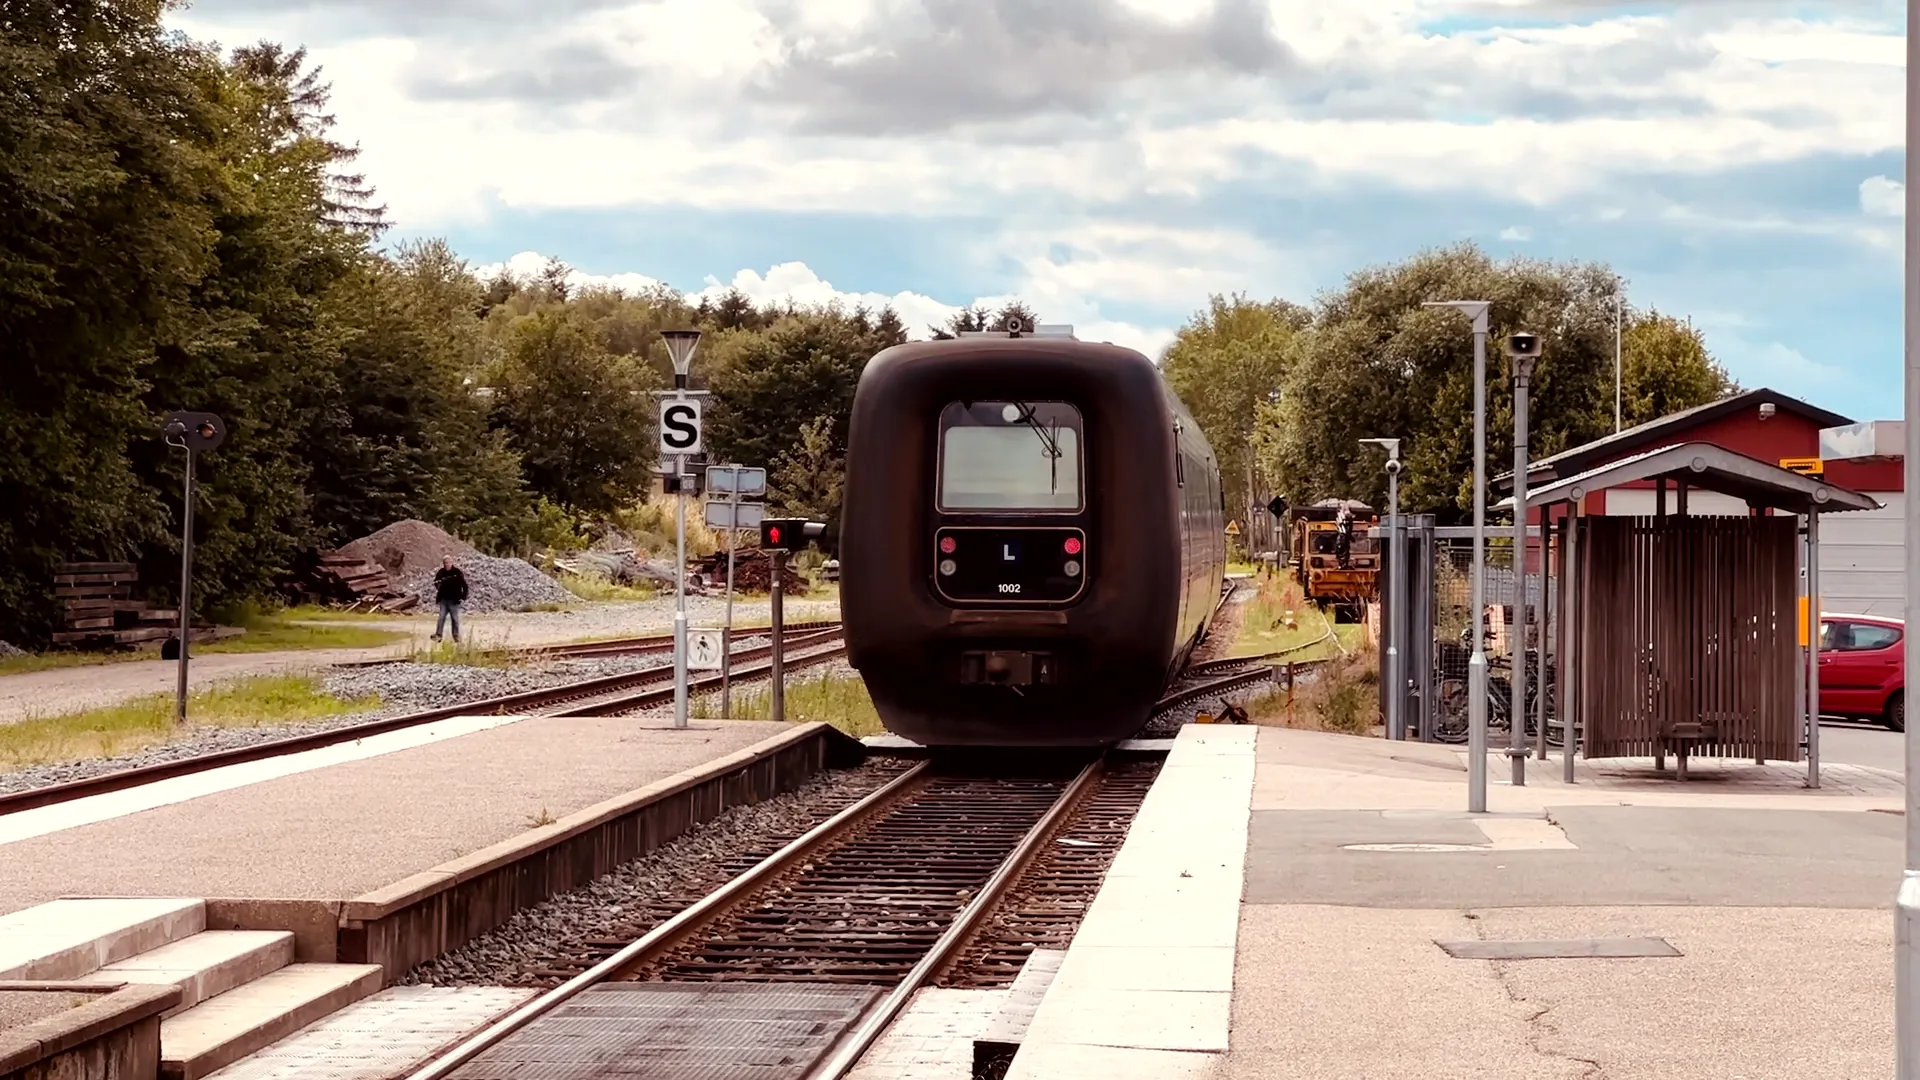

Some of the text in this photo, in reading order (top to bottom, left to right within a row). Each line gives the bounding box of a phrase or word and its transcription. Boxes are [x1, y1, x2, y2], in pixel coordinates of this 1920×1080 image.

[662, 405, 698, 448] S
[1003, 544, 1016, 561] L
[997, 583, 1021, 593] 1002
